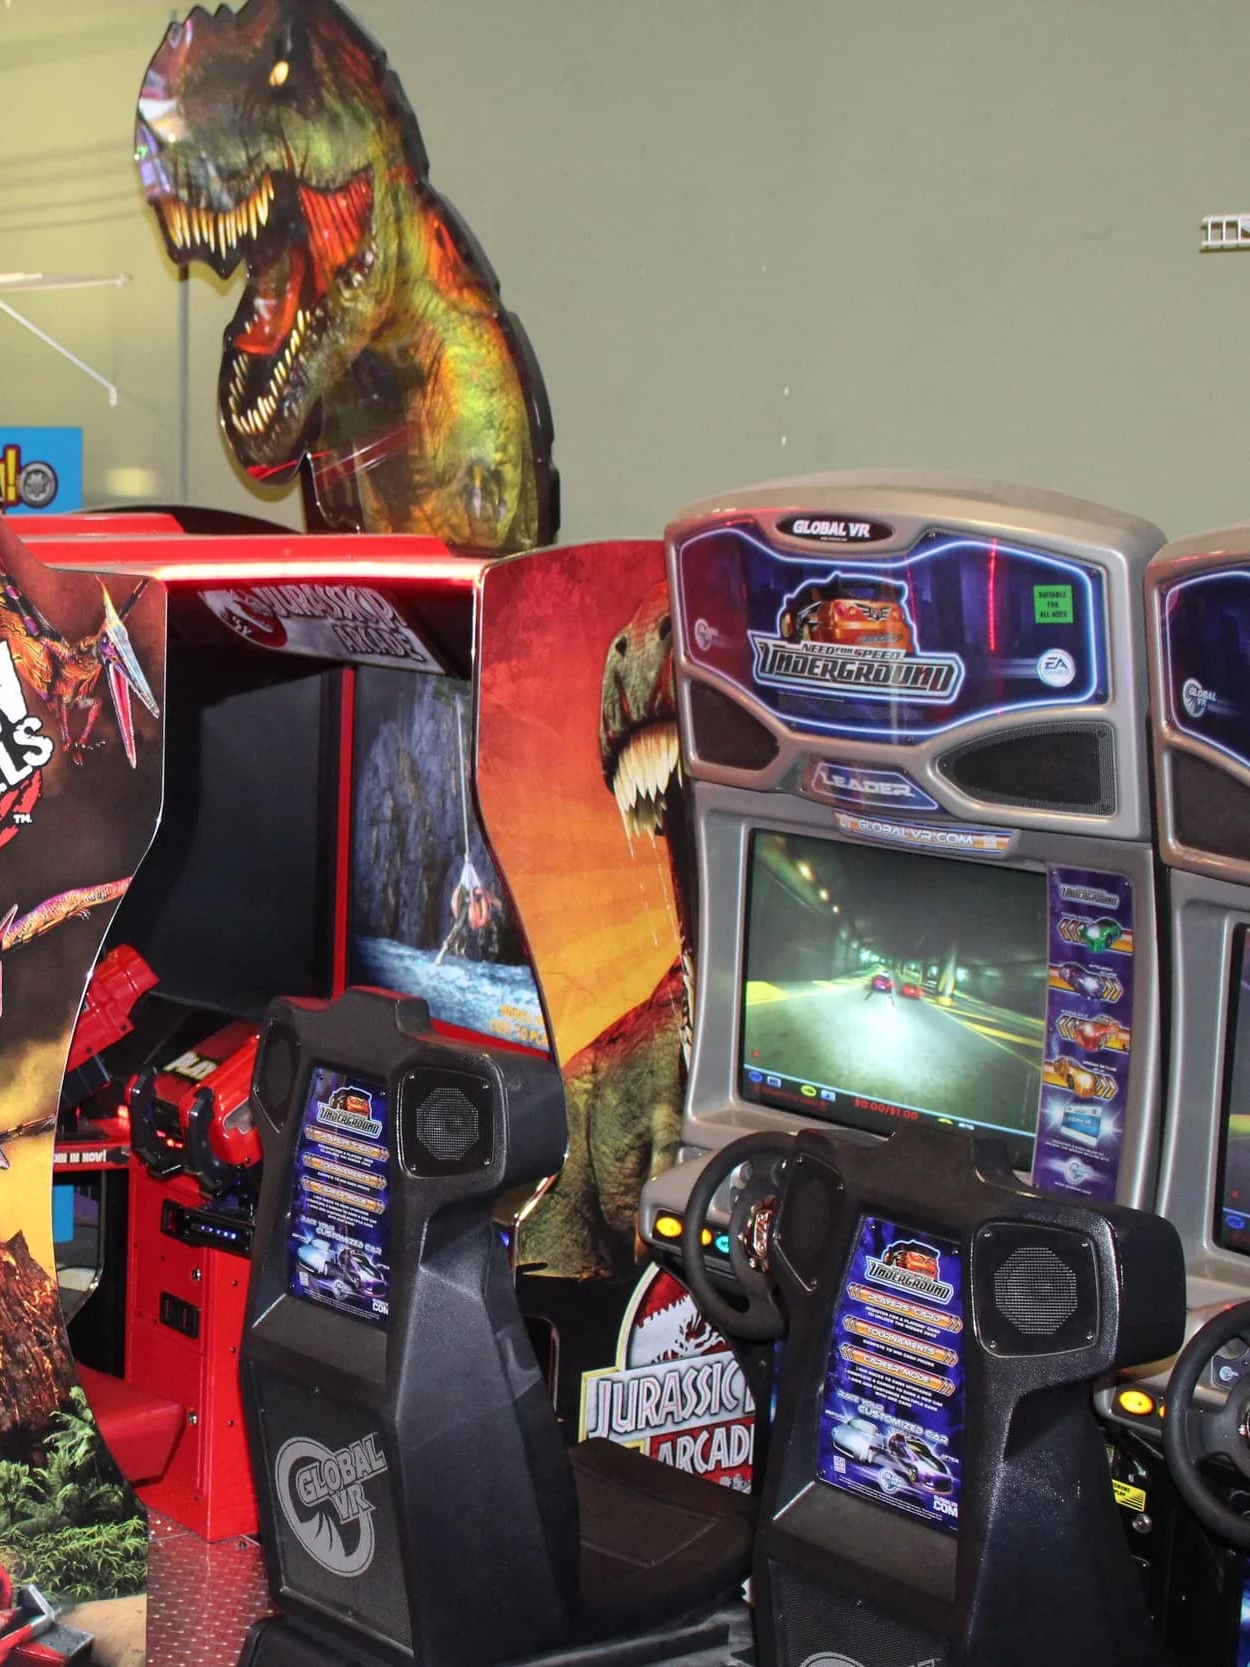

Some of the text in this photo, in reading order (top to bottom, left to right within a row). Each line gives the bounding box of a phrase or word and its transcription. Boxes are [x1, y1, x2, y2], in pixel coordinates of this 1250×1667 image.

[793, 519, 871, 538] GLOBAL VR
[757, 642, 955, 693] UNDERGROUND
[801, 642, 835, 655] NEED
[855, 648, 904, 660] SPEED
[1044, 656, 1068, 670] EA
[819, 771, 916, 798] LEADER
[588, 1360, 742, 1439] JURASSIC
[856, 1404, 925, 1436] CUSTOMIZED
[658, 1425, 754, 1474] ARCAD
[298, 1434, 387, 1505] GLOBAL
[330, 1481, 375, 1523] VR
